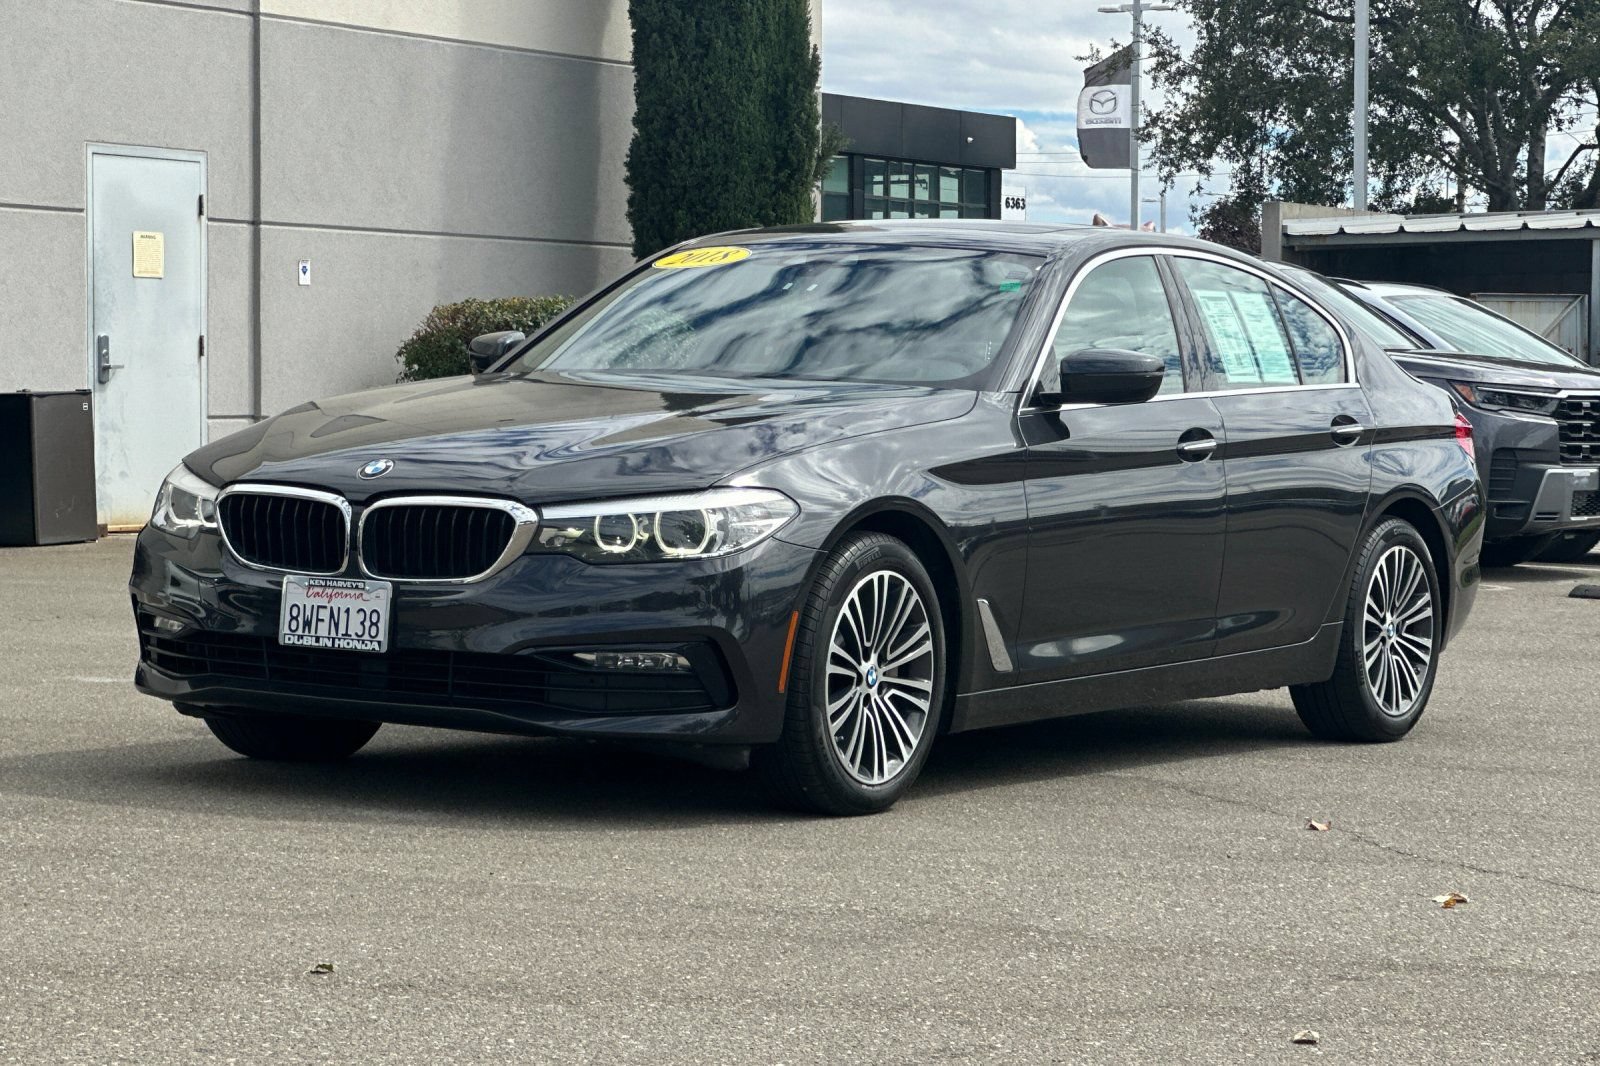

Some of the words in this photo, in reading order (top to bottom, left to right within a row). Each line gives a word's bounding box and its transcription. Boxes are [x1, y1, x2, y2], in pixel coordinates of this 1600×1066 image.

[1005, 196, 1026, 210] 6363
[663, 250, 741, 266] 2018
[309, 579, 325, 587] KEN
[326, 580, 365, 589] HARVEY'S
[306, 586, 371, 604] California
[288, 603, 381, 639] 8WFN138
[284, 634, 332, 648] DUBLIN
[334, 638, 380, 651] HONDA
